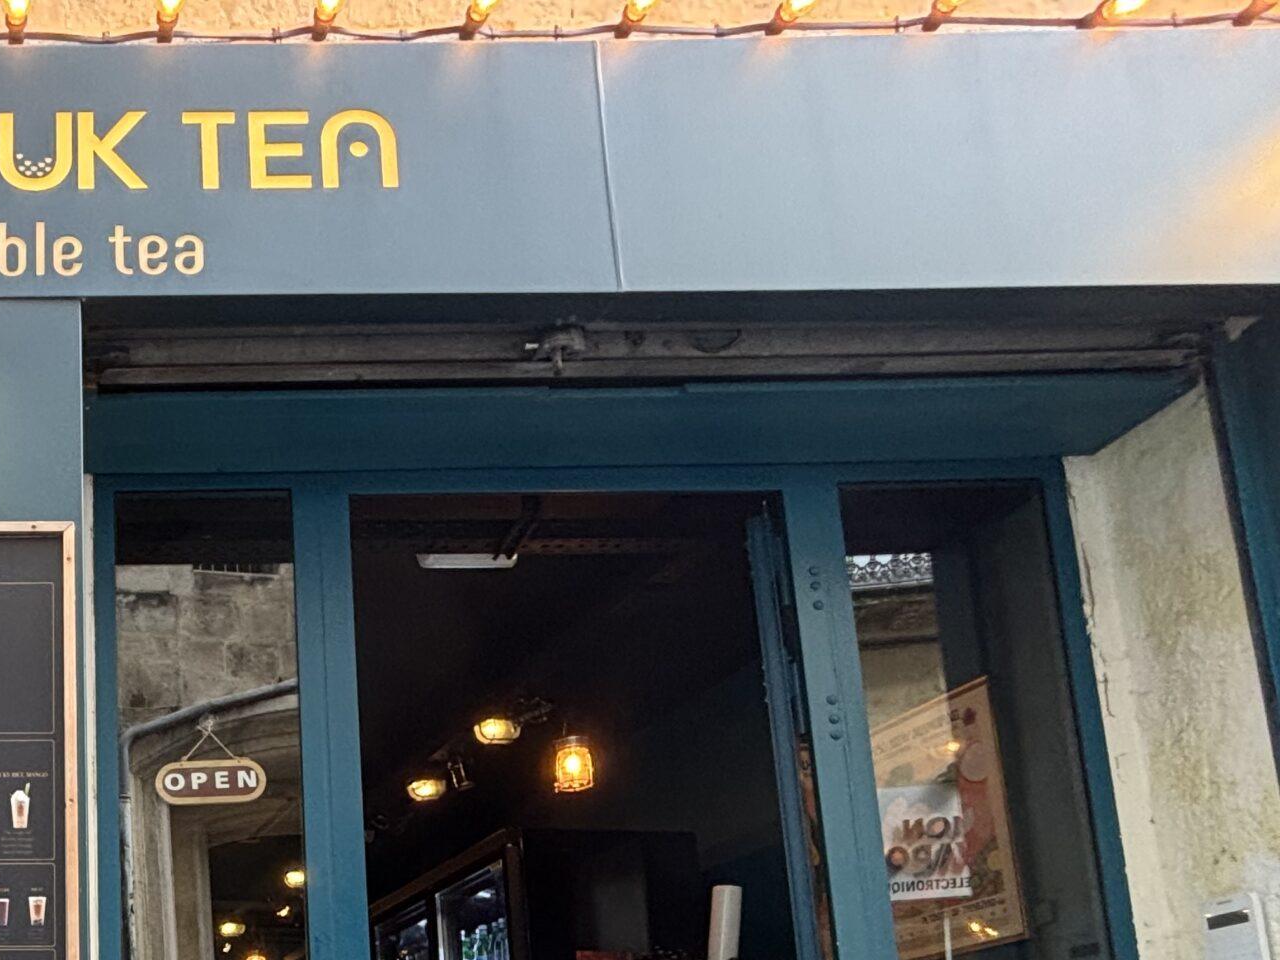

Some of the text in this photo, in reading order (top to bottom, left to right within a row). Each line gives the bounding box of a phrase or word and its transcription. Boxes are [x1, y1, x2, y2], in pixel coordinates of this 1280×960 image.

[181, 109, 399, 189] TEA
[108, 224, 206, 275] tea
[164, 769, 257, 791] OPEN
